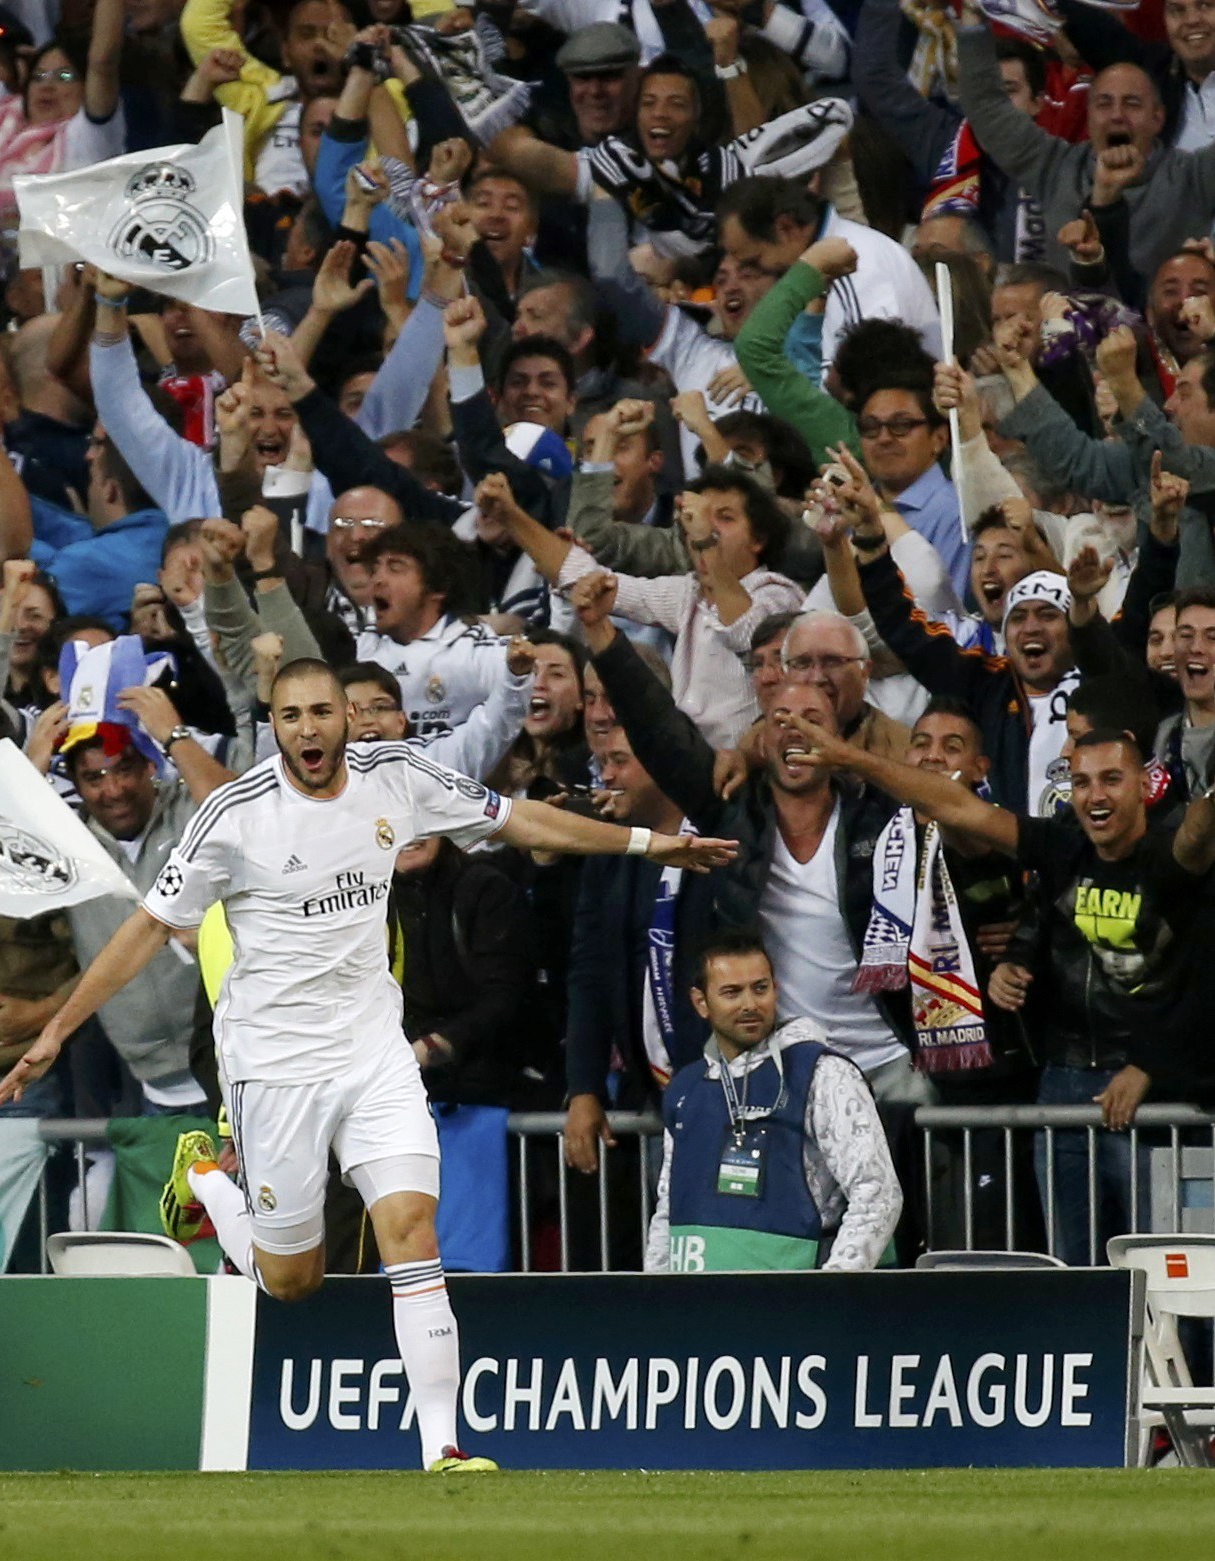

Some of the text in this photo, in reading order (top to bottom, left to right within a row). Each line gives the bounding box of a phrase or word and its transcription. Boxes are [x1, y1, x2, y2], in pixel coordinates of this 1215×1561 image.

[336, 871, 364, 890] Fly
[1075, 886, 1142, 919] EARN
[937, 1026, 985, 1047] MADRID
[462, 1355, 827, 1432] CHAMPIONS
[855, 1353, 1093, 1428] LEAGUE
